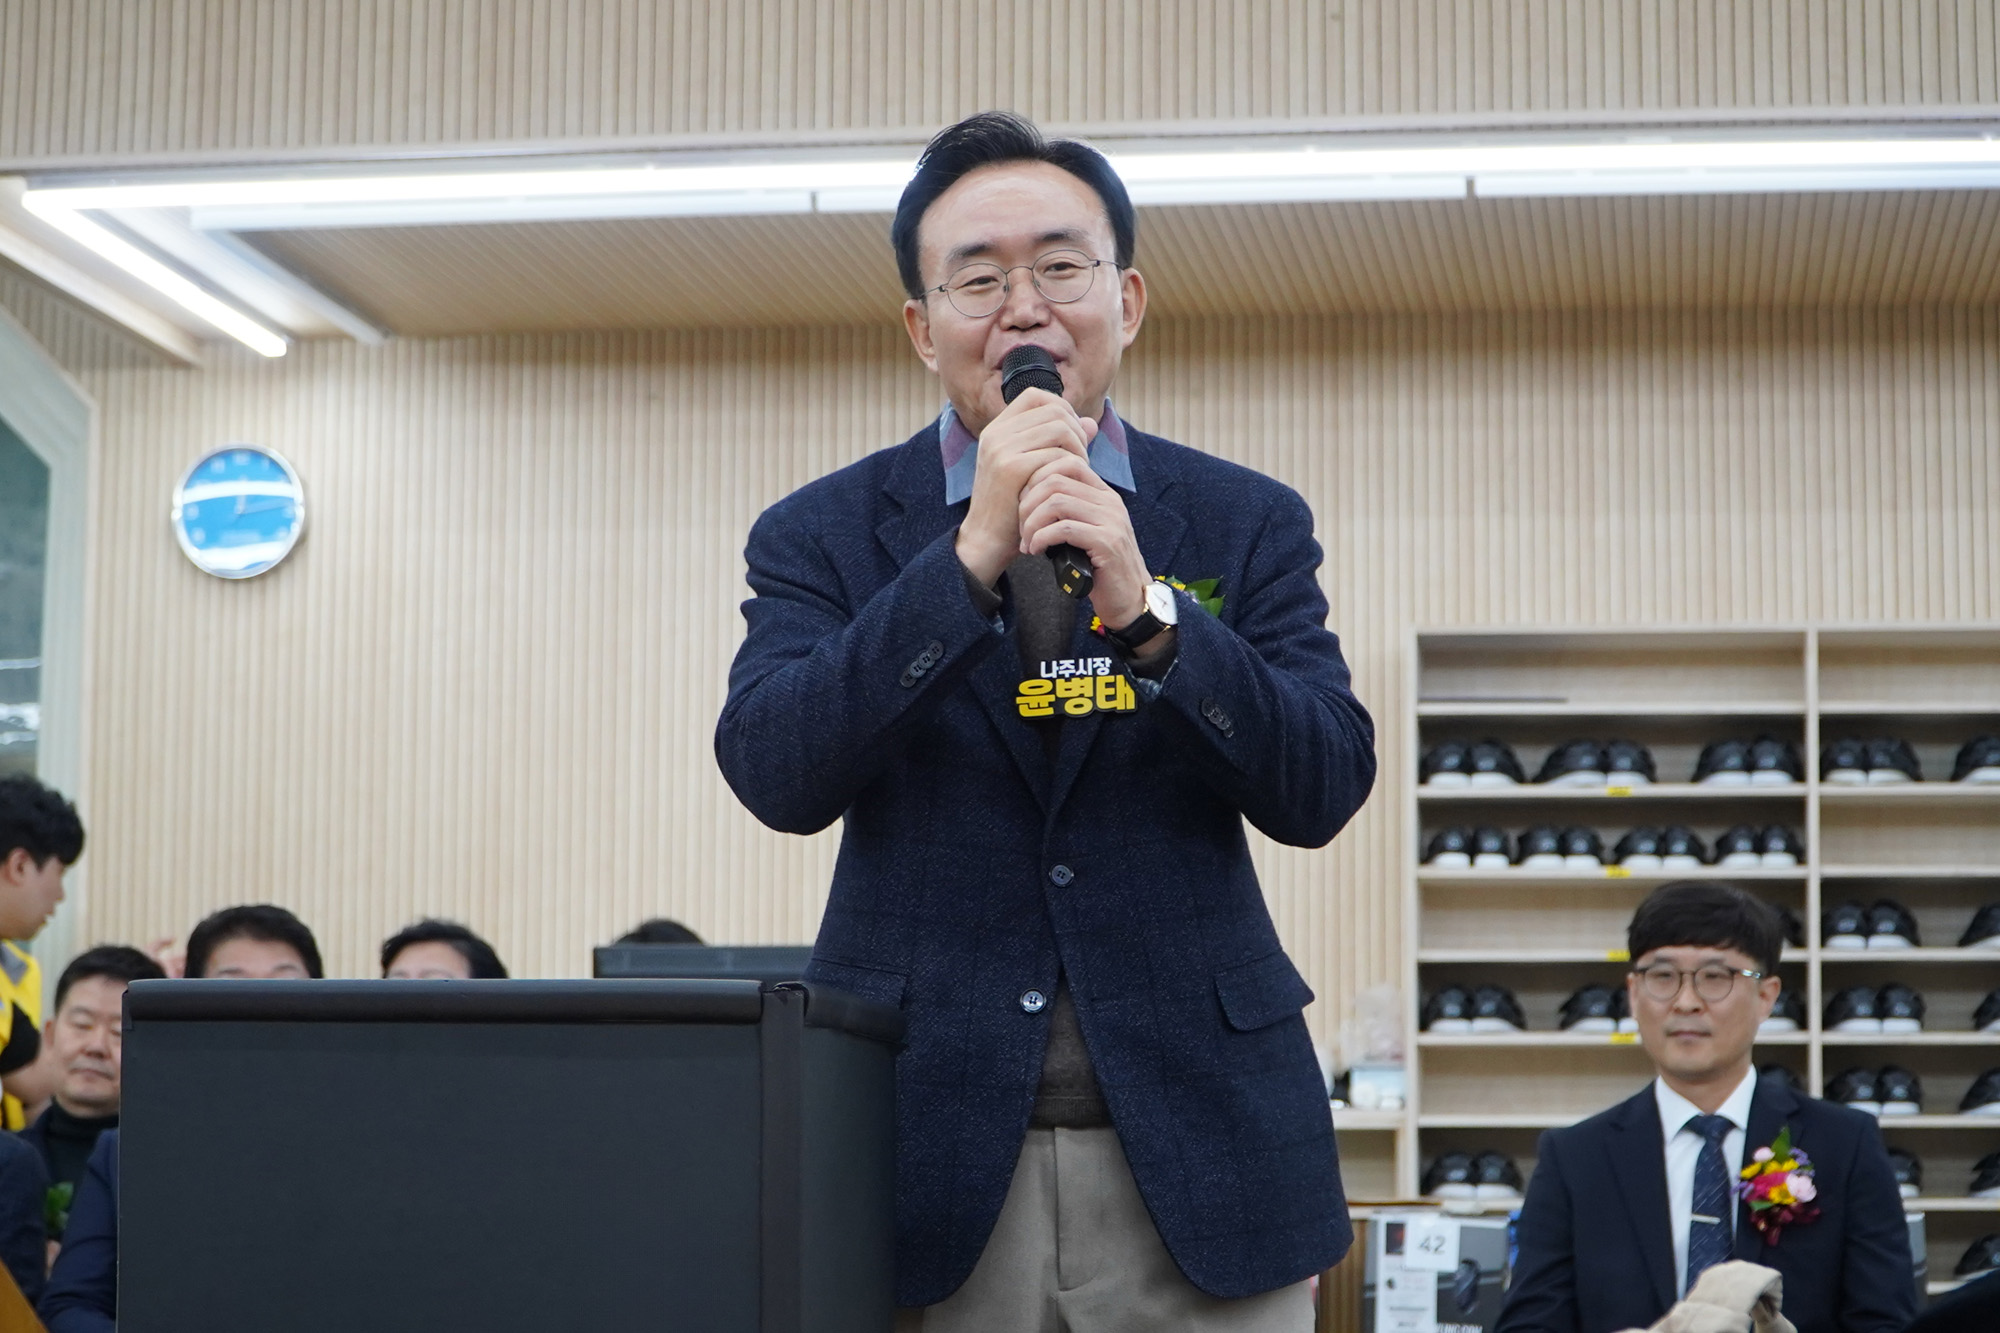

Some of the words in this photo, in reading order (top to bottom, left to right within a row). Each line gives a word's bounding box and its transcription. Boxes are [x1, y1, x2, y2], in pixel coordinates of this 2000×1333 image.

[1040, 657, 1112, 678] 나주시장
[1015, 675, 1136, 717] 윤병태
[1418, 1235, 1446, 1254] 42
